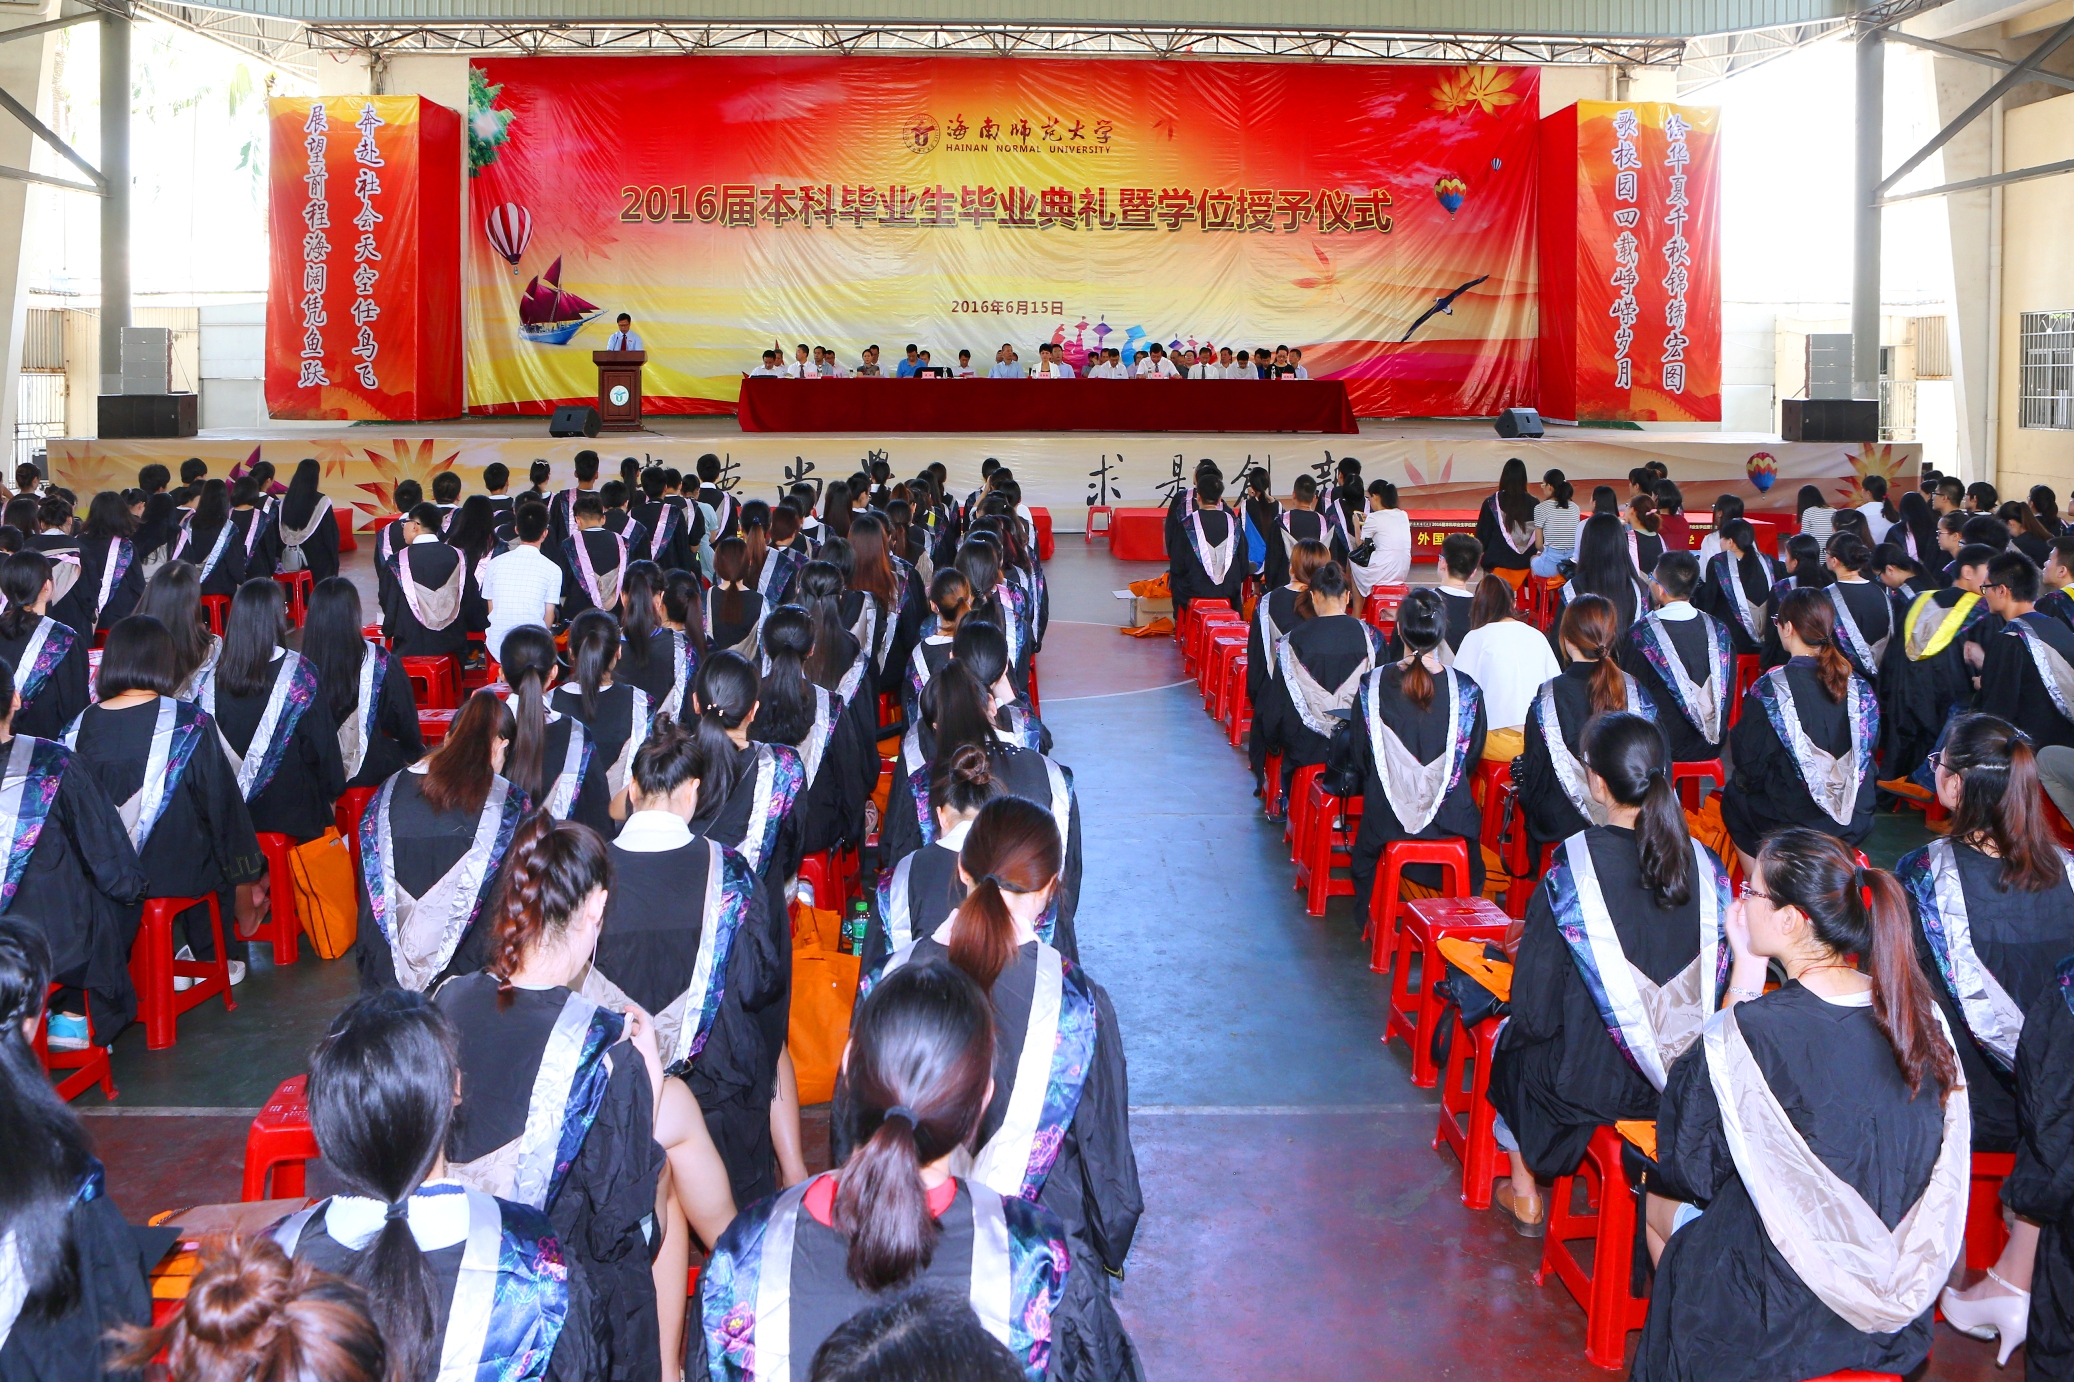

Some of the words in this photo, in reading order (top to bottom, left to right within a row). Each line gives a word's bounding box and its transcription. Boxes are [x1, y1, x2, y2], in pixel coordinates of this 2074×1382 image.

[620, 183, 1393, 233] 2016届本科毕业生毕业典礼暨学位授予仪式
[946, 113, 1113, 145] 海南师范大学
[946, 144, 988, 152] HAINAN
[996, 144, 1042, 153] NORMAL
[1049, 145, 1111, 154] UNIVERSITY
[300, 104, 330, 387] 展望前程海阔凭鱼跃
[353, 104, 383, 387] 奔赴社会天空任鸟飞
[951, 300, 1063, 315] 2016年6月15日
[1611, 111, 1640, 387] 歌校园四载峥嵘岁月
[1663, 115, 1690, 392] 绘华夏千秋锦绣宏图
